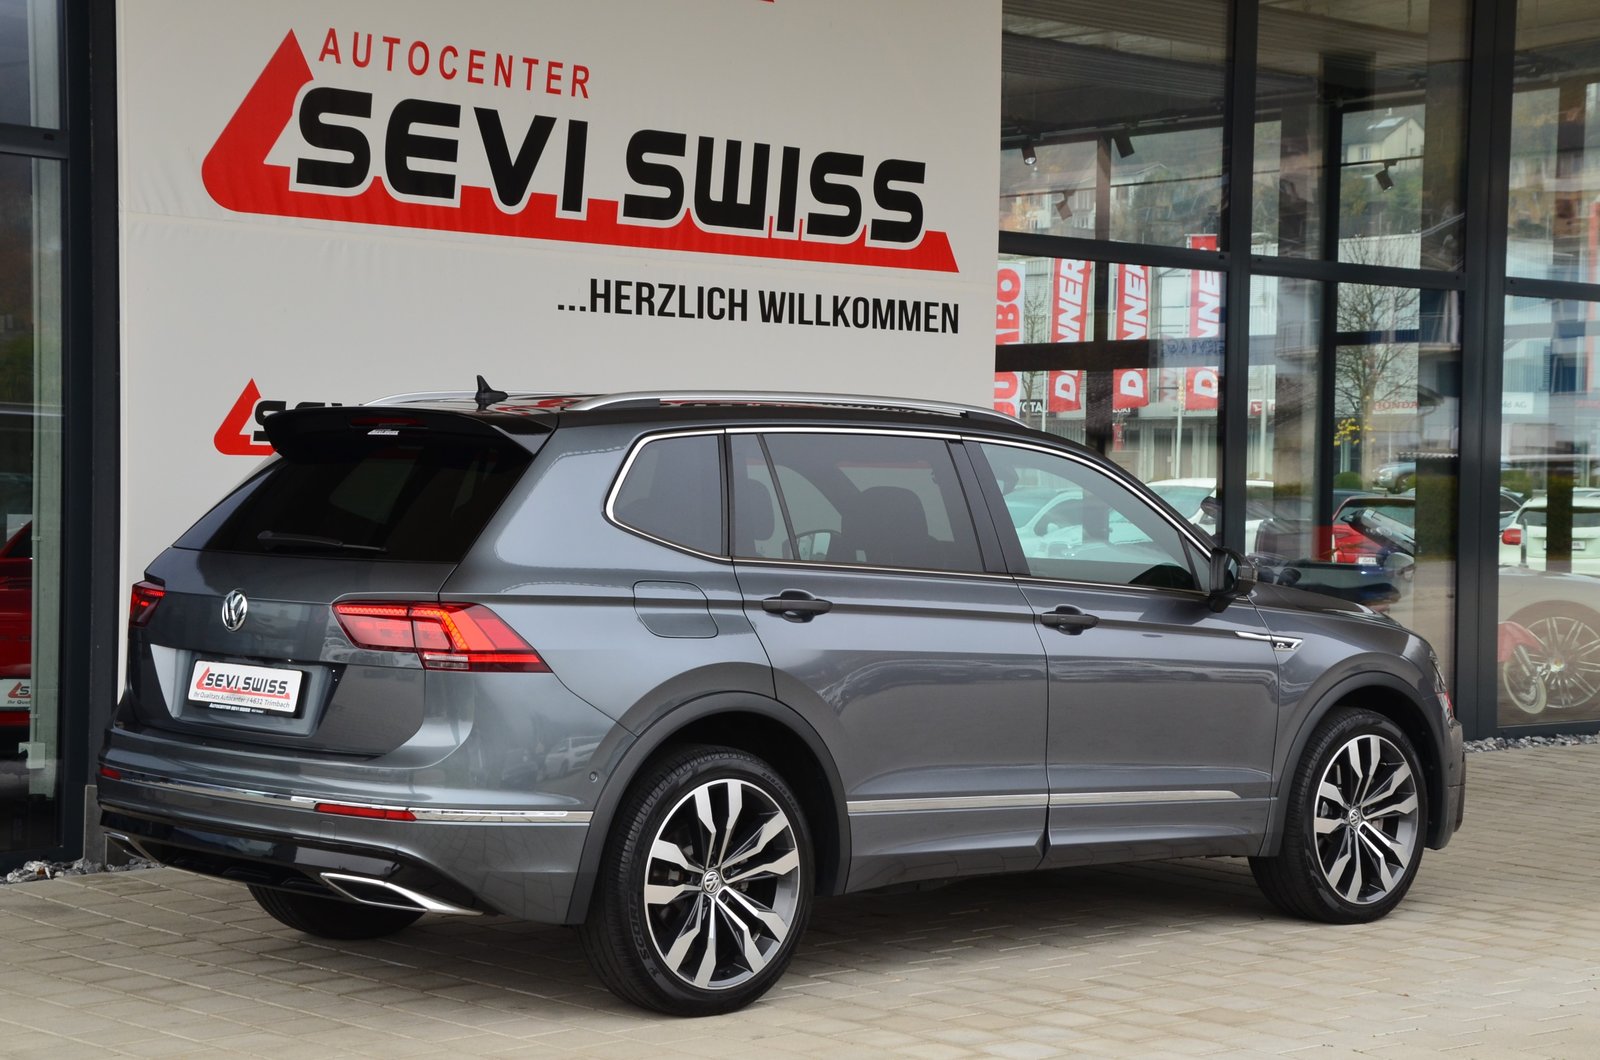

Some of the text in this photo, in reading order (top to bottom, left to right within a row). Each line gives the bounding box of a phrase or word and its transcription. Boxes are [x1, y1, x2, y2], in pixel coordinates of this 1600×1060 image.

[319, 28, 590, 99] AUTOCENTER
[295, 87, 926, 246] SEVI SWISS
[758, 290, 960, 334] WILLKOMMEN
[1055, 258, 1084, 401] DNNER
[205, 673, 289, 695] SEVI SWISS
[221, 694, 247, 702] Autocenter
[264, 699, 291, 709] Trimbach
